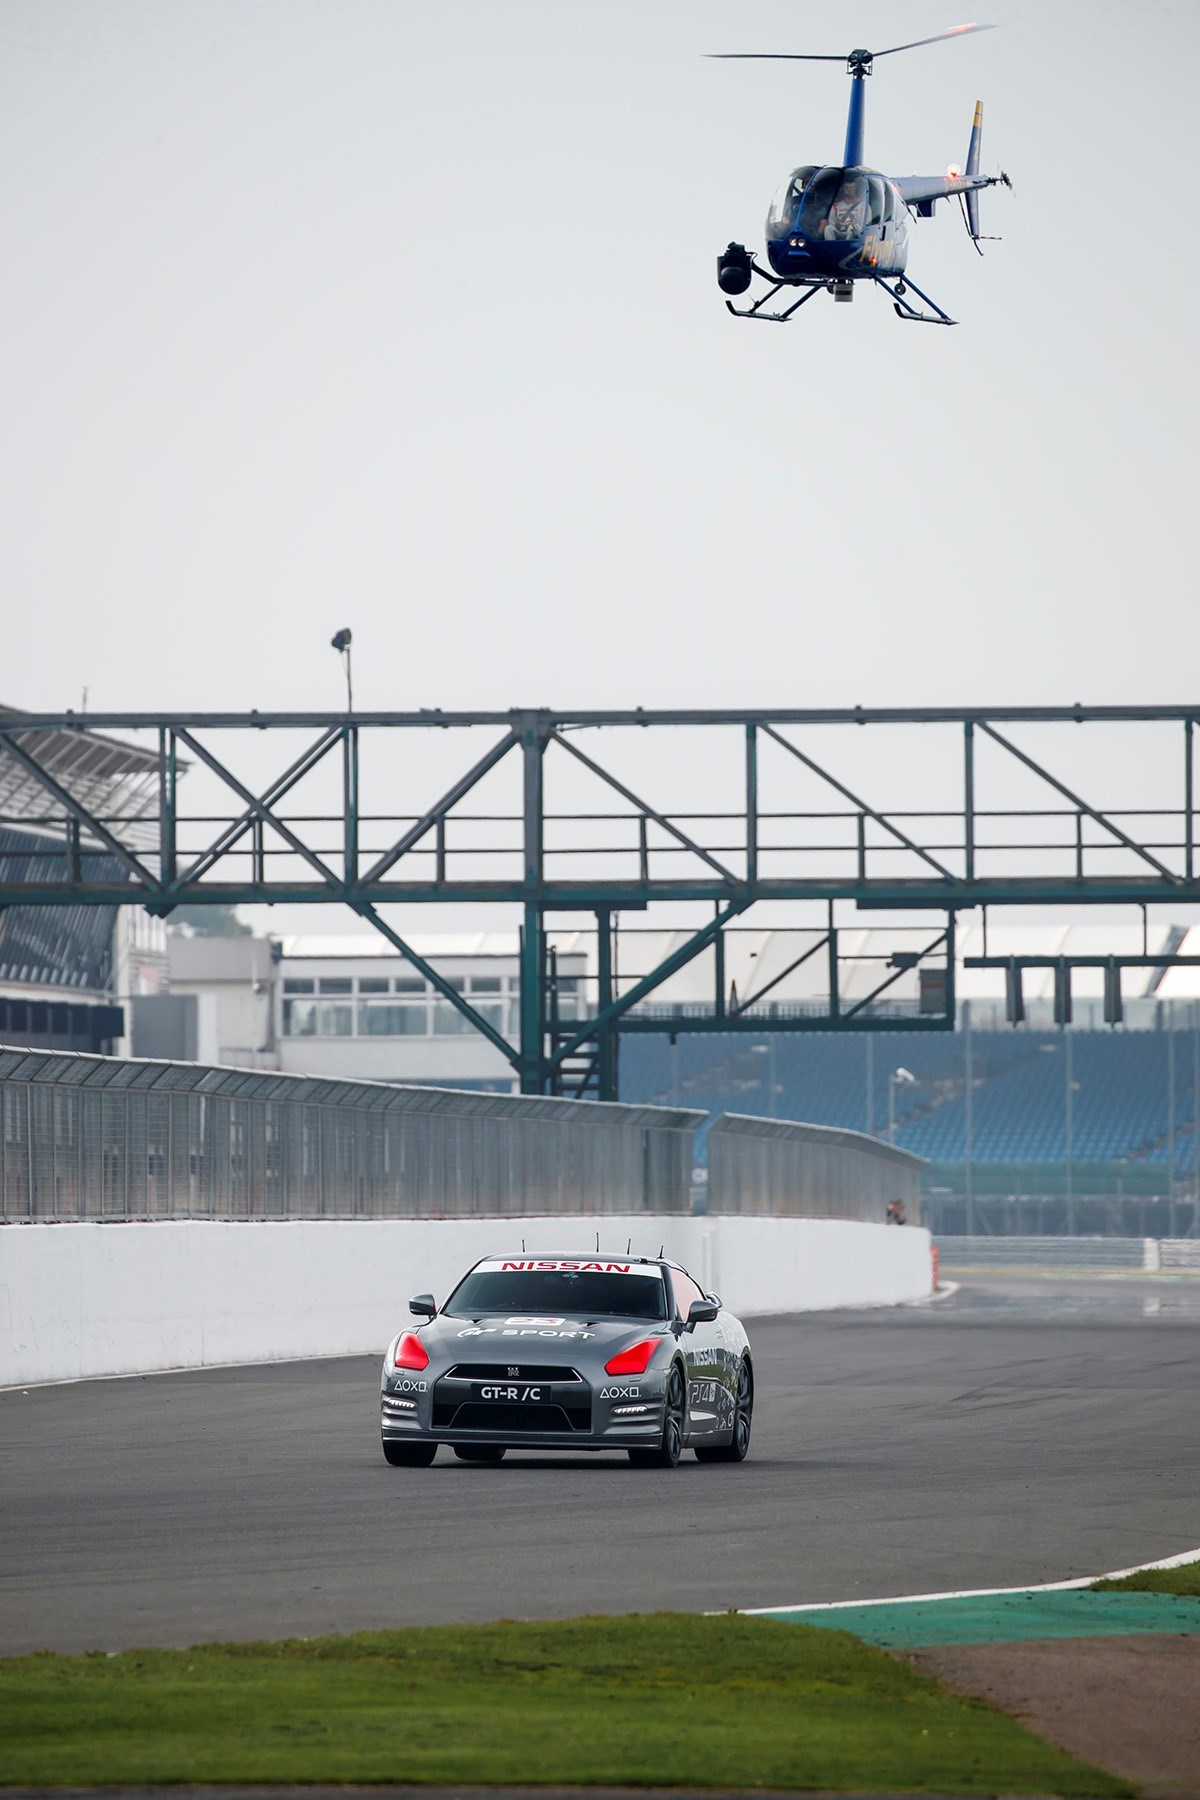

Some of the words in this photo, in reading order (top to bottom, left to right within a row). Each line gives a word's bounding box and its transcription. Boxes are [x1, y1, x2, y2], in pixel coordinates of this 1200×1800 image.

[501, 1261, 631, 1273] NISSAN
[501, 1329, 596, 1340] SPORT
[693, 1347, 718, 1367] NISSAN
[480, 1386, 518, 1400] GT-R
